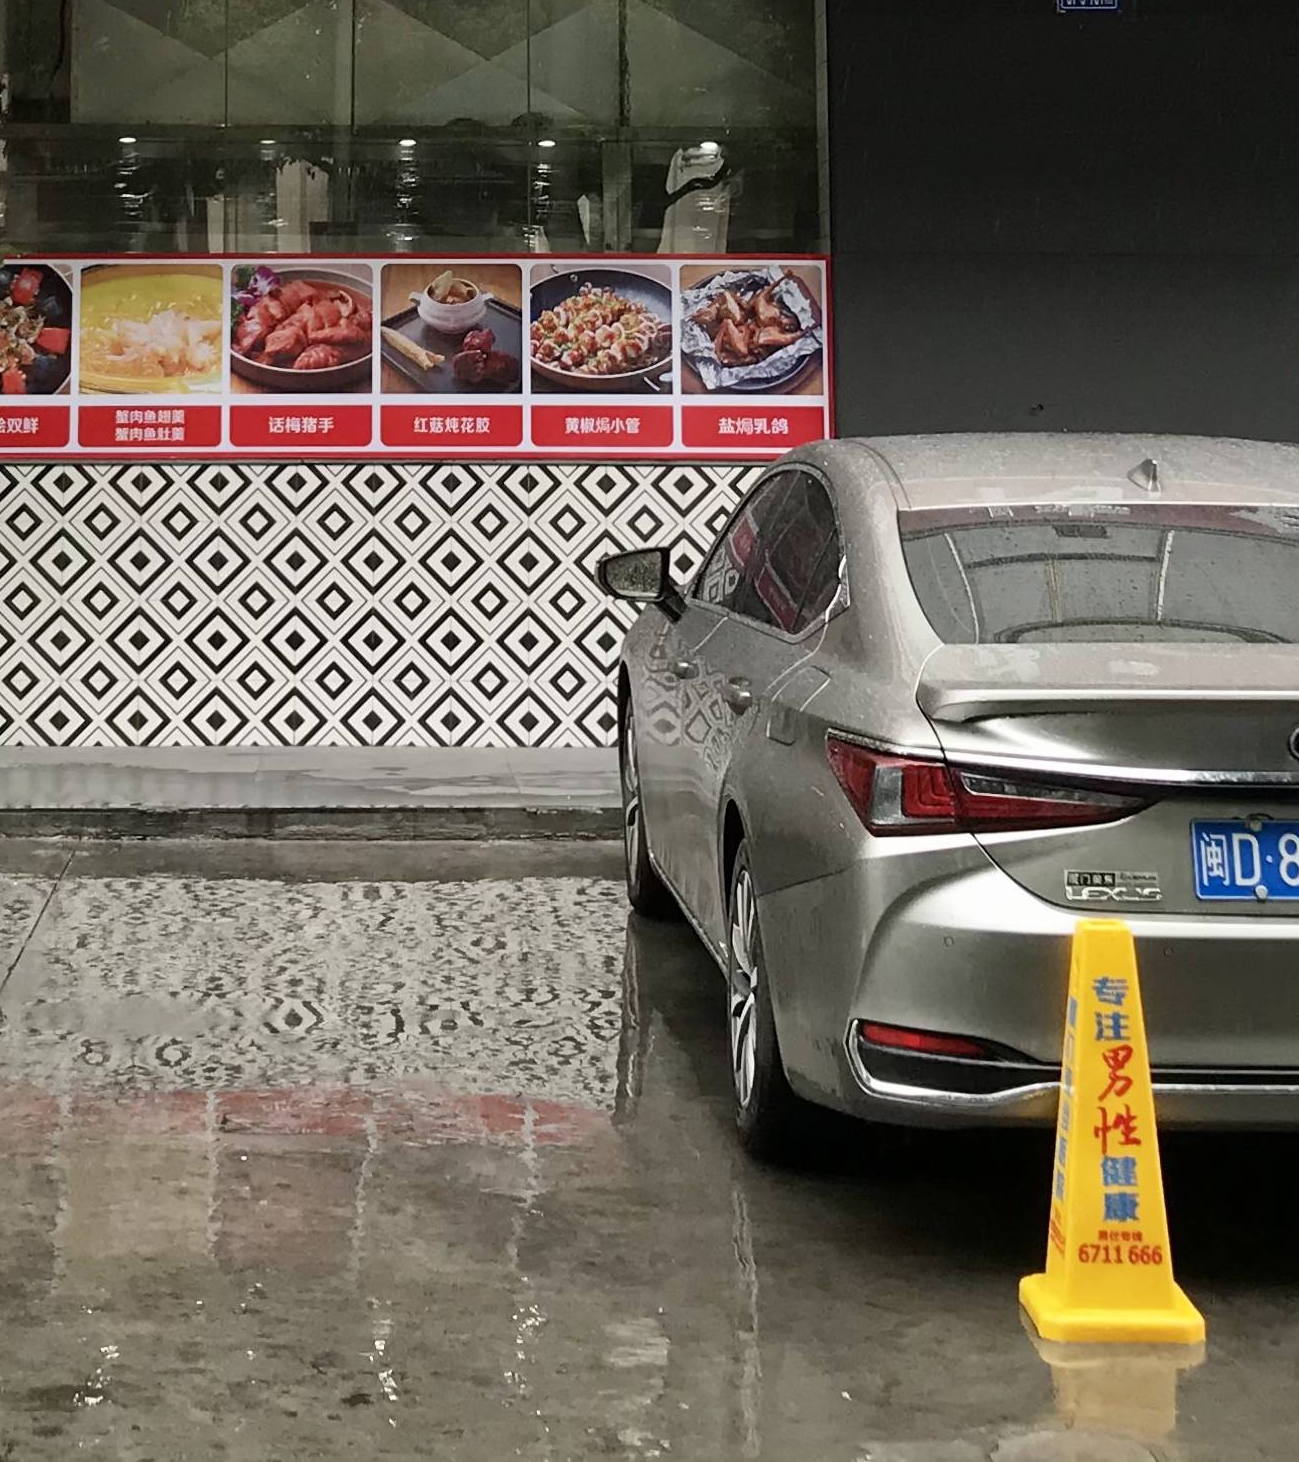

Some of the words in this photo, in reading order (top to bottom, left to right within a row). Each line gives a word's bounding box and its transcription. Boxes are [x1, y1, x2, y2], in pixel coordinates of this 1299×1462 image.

[268, 416, 334, 435] 话梅猪手
[413, 416, 491, 435] 红菇炖花胶
[564, 416, 640, 435] 黄椒焗小管
[718, 416, 789, 435] 盐焗乳鸽
[1065, 886, 1162, 902] LEXUS
